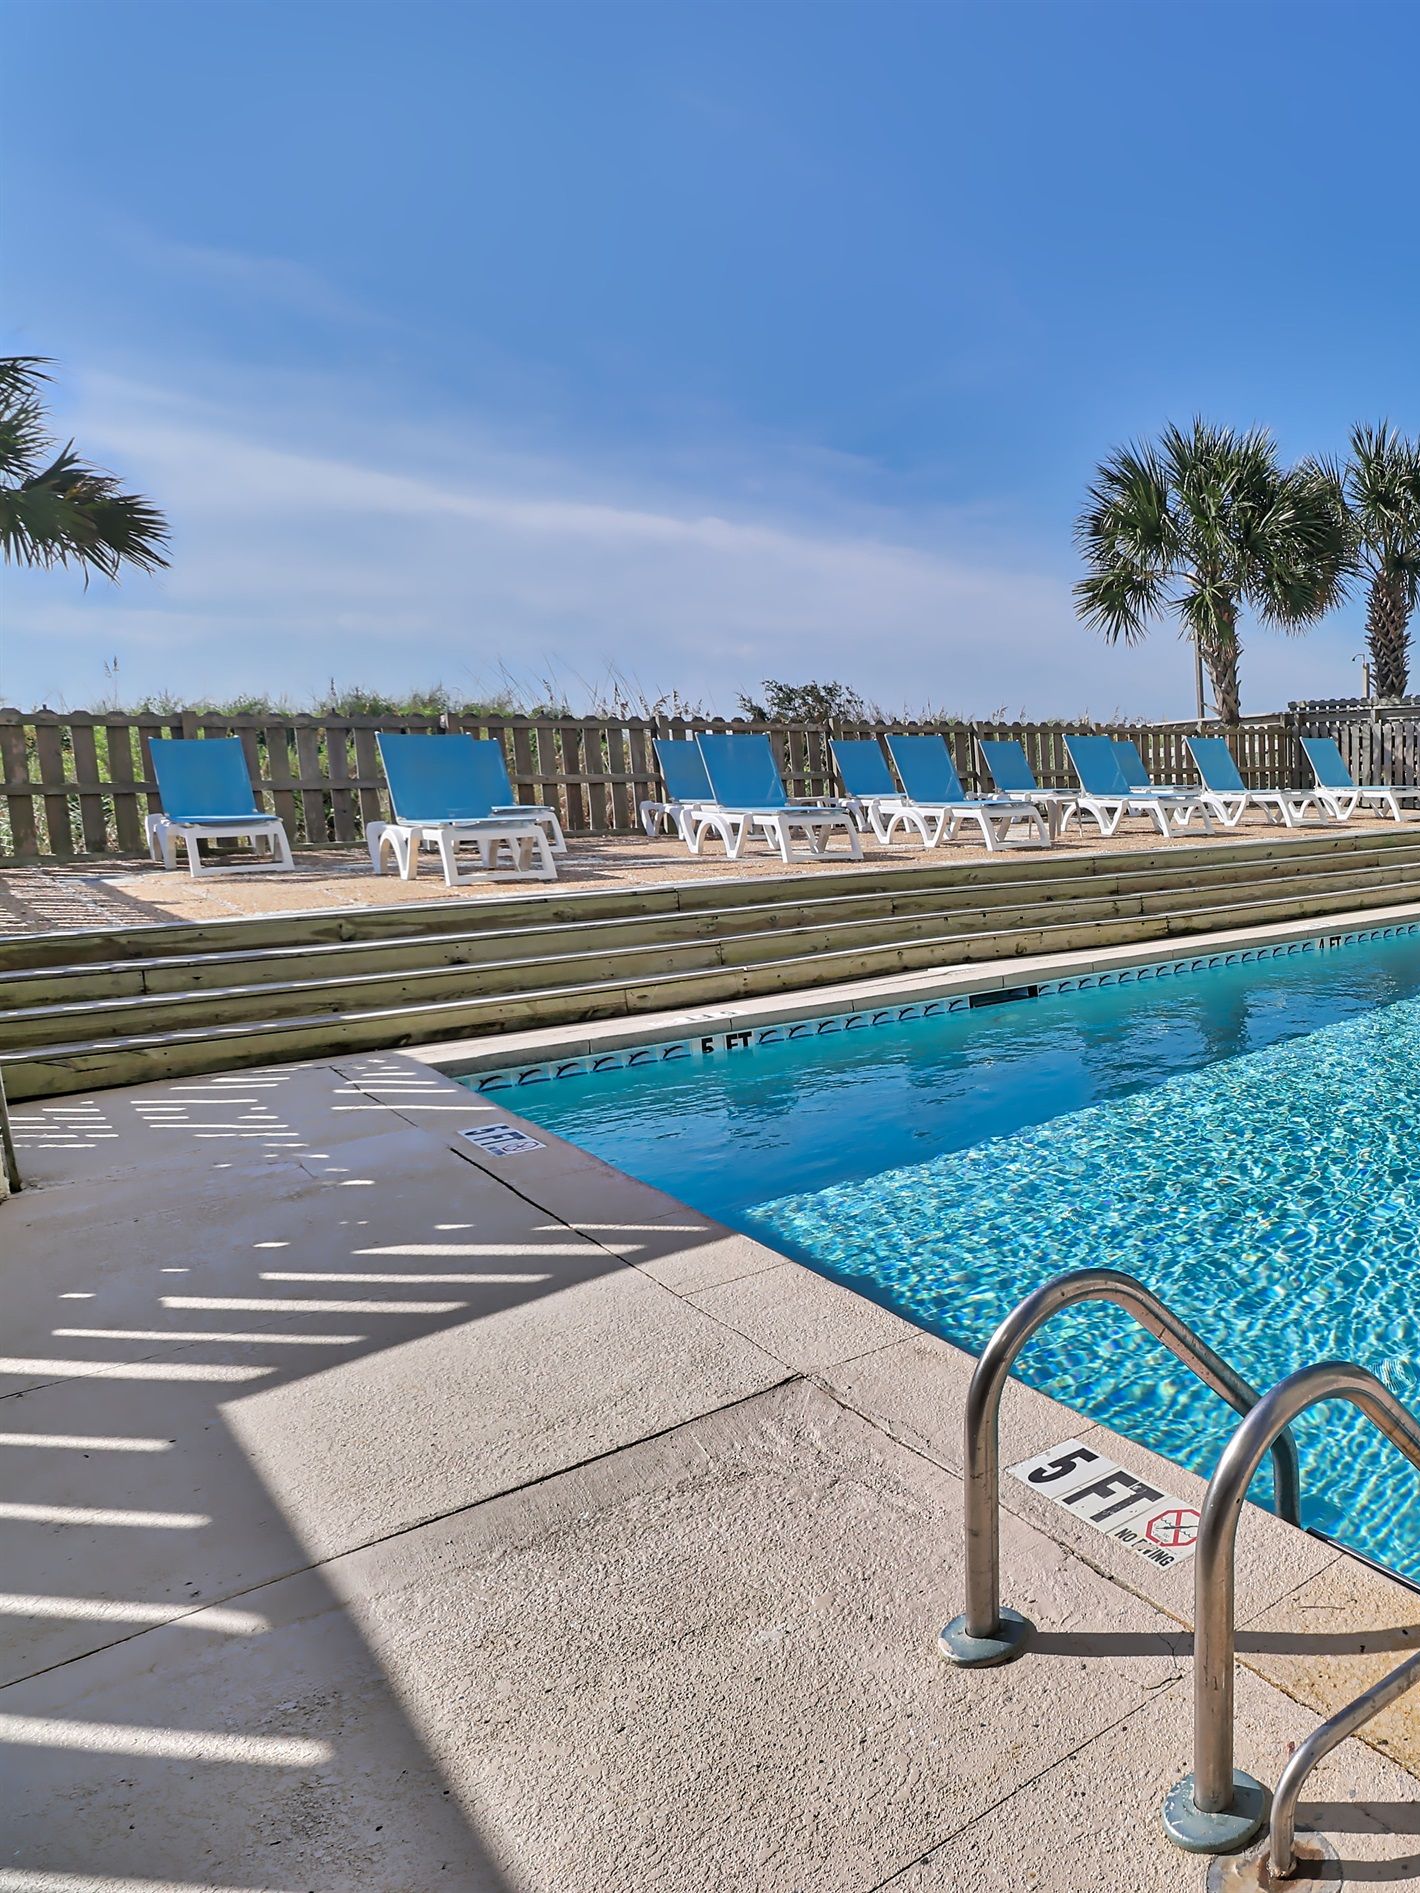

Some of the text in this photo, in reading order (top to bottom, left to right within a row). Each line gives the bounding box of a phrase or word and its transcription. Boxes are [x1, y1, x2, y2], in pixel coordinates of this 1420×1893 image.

[1330, 936, 1341, 947] FT
[701, 1031, 752, 1053] 5 FT
[465, 1125, 527, 1146] 5 FT
[1027, 1447, 1165, 1523] 5 FT
[1114, 1528, 1138, 1542] NO
